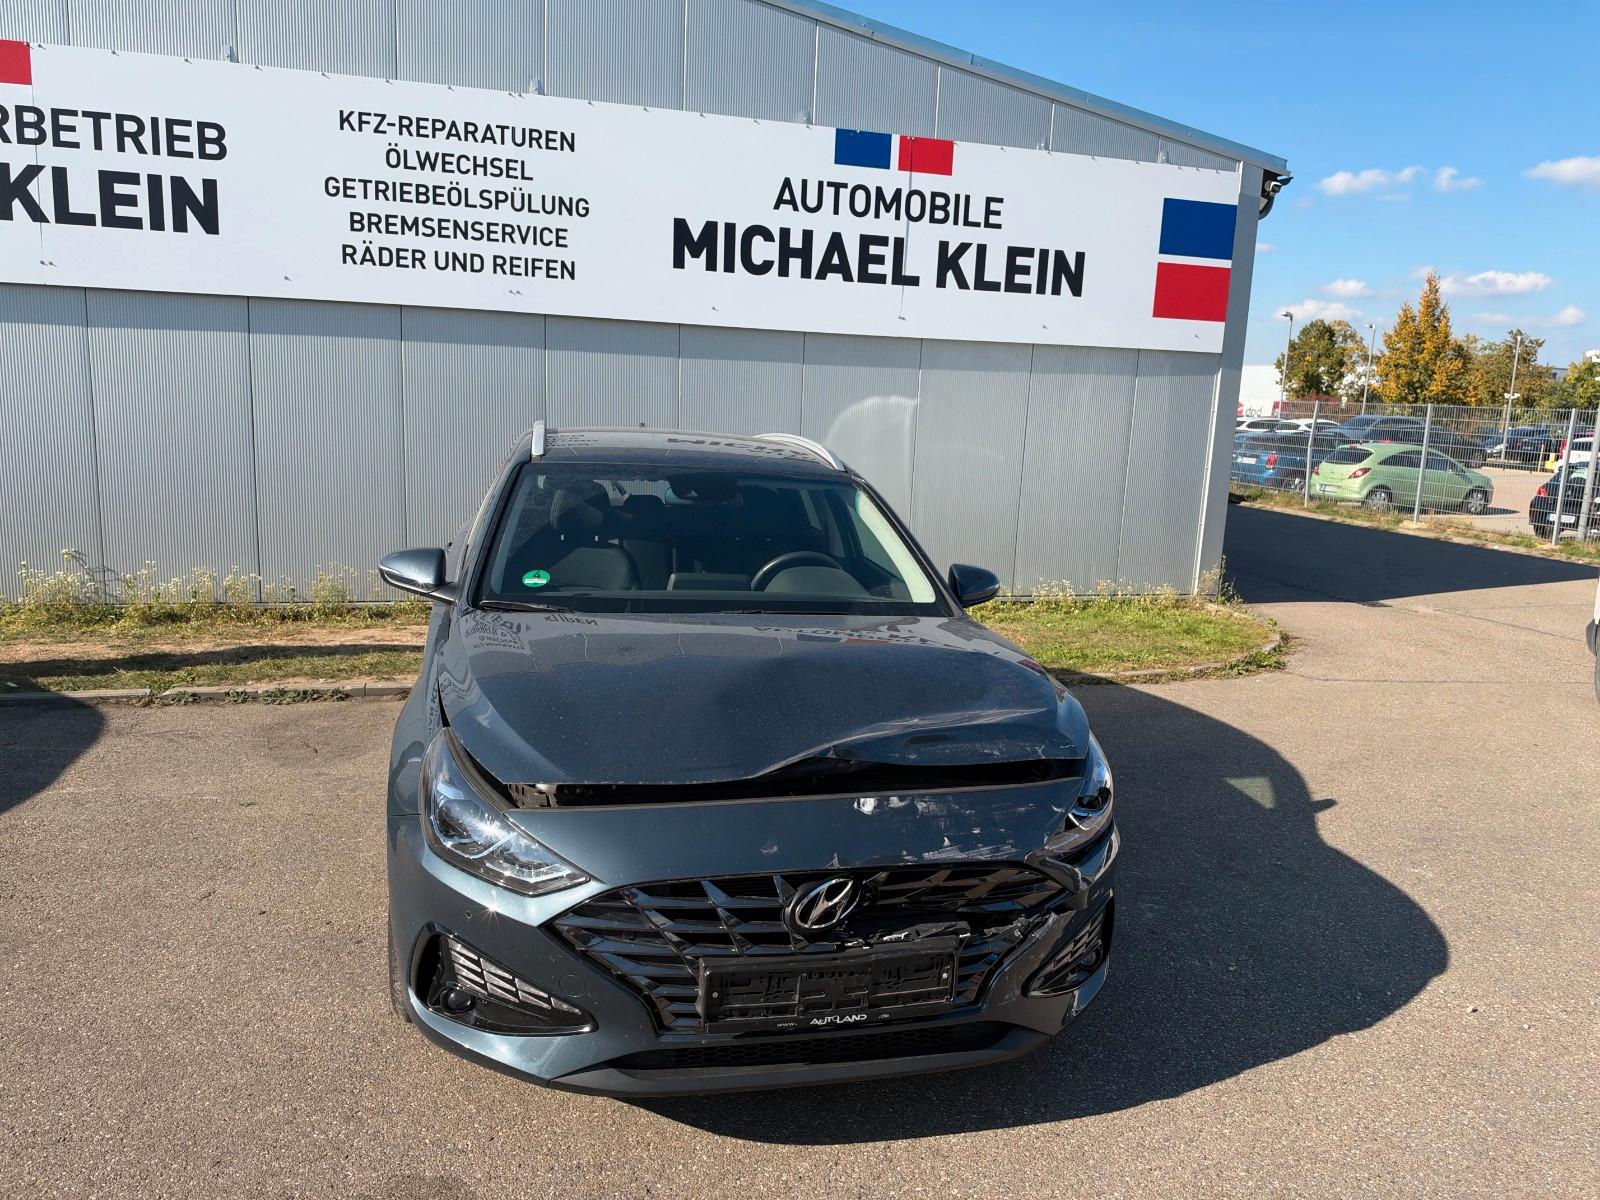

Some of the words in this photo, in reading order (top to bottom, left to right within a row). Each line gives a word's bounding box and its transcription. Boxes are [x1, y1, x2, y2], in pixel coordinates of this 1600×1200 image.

[339, 110, 576, 153] KFZ-REPARATUREN
[386, 142, 533, 181] ÖLWECHSEL
[0, 162, 219, 235] KLEIN
[325, 177, 589, 217] GETRIEBEÖLSPÜLUNG
[773, 176, 1003, 229] AUTOMOBILE
[350, 212, 567, 248] BREMSENSERVICE
[342, 240, 426, 270] RÄDER
[434, 251, 484, 275] UND
[493, 255, 575, 280] REIFEN
[673, 217, 919, 287] MICHAEL
[936, 241, 1085, 298] KLEIN
